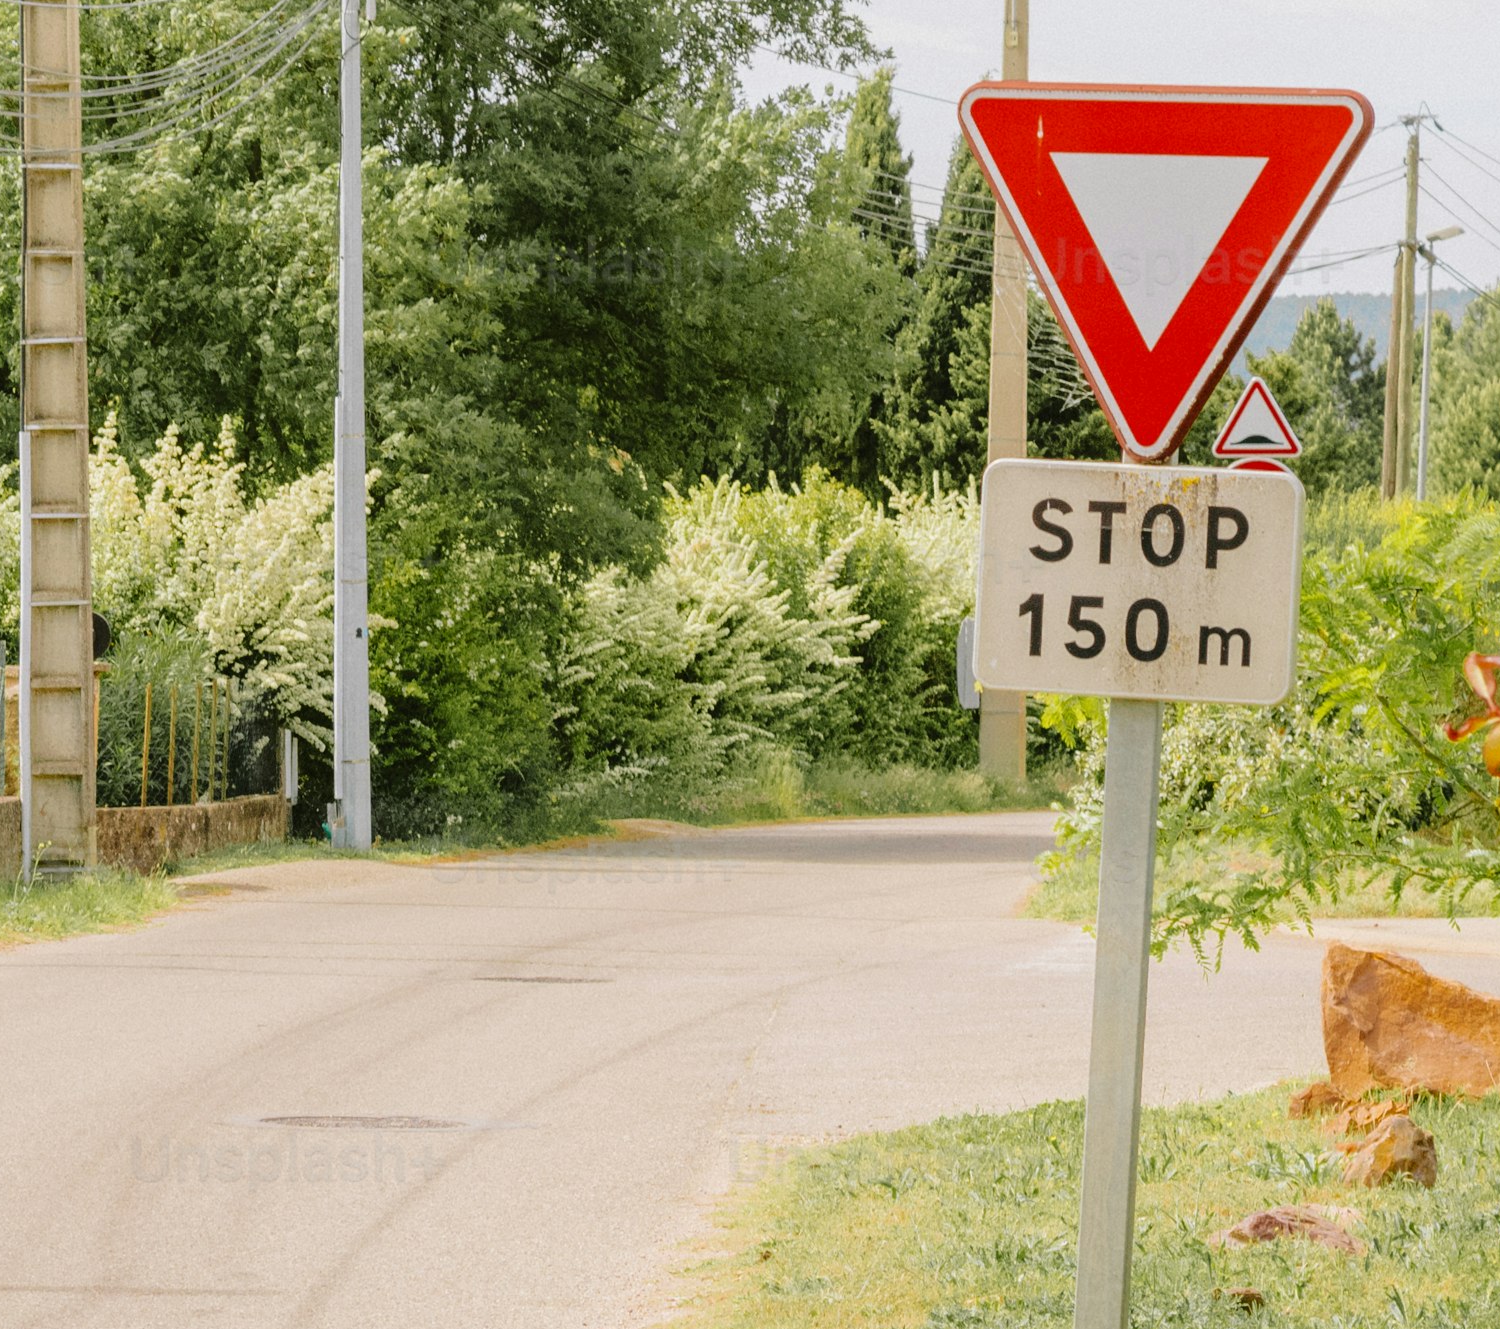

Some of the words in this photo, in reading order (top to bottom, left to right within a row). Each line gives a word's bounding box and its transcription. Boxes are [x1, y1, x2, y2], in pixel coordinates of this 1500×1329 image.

[1029, 498, 1249, 570] STOP
[1018, 593, 1170, 663] 150
[1198, 624, 1252, 667] m
